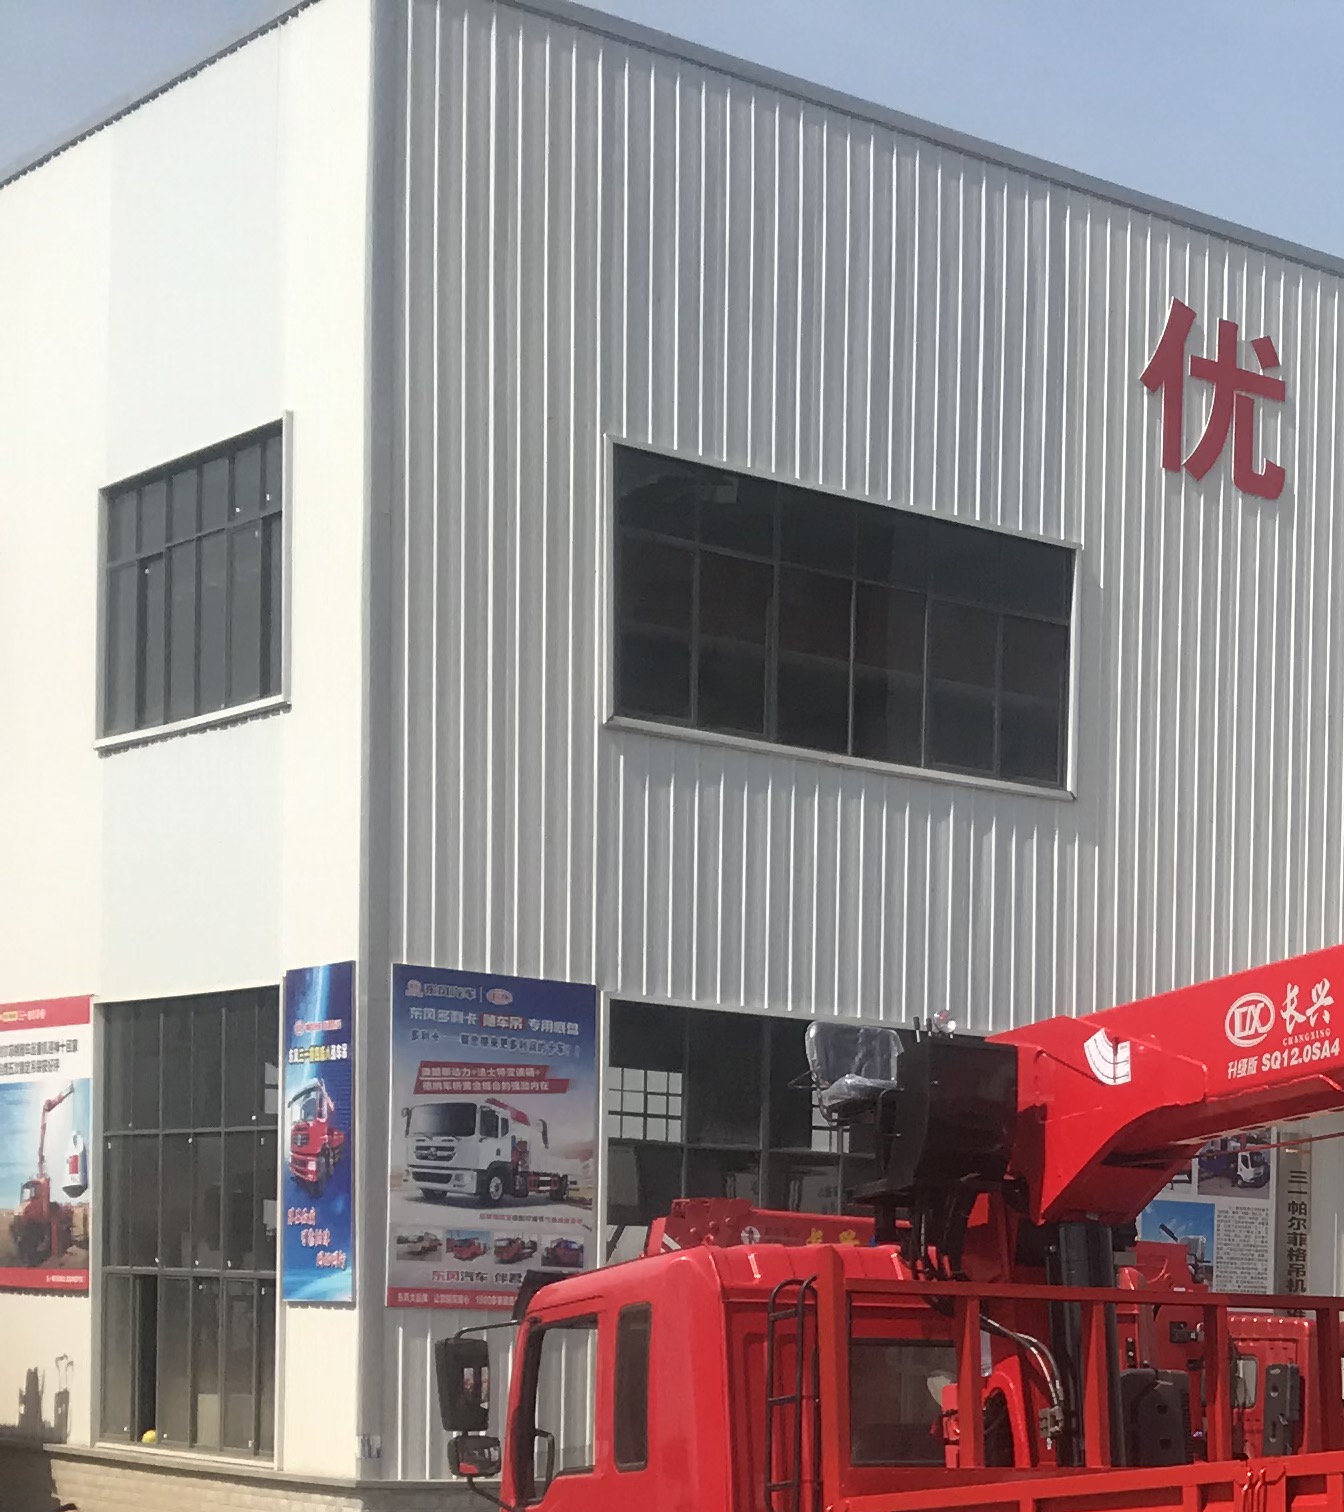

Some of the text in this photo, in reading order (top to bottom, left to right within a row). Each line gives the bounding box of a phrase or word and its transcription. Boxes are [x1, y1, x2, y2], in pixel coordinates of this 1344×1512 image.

[1282, 1027, 1332, 1047] CHANGXING
[1260, 1038, 1341, 1072] SQ12.0SA4
[1286, 1169, 1309, 1318] 三一帕尔菲格吊机
